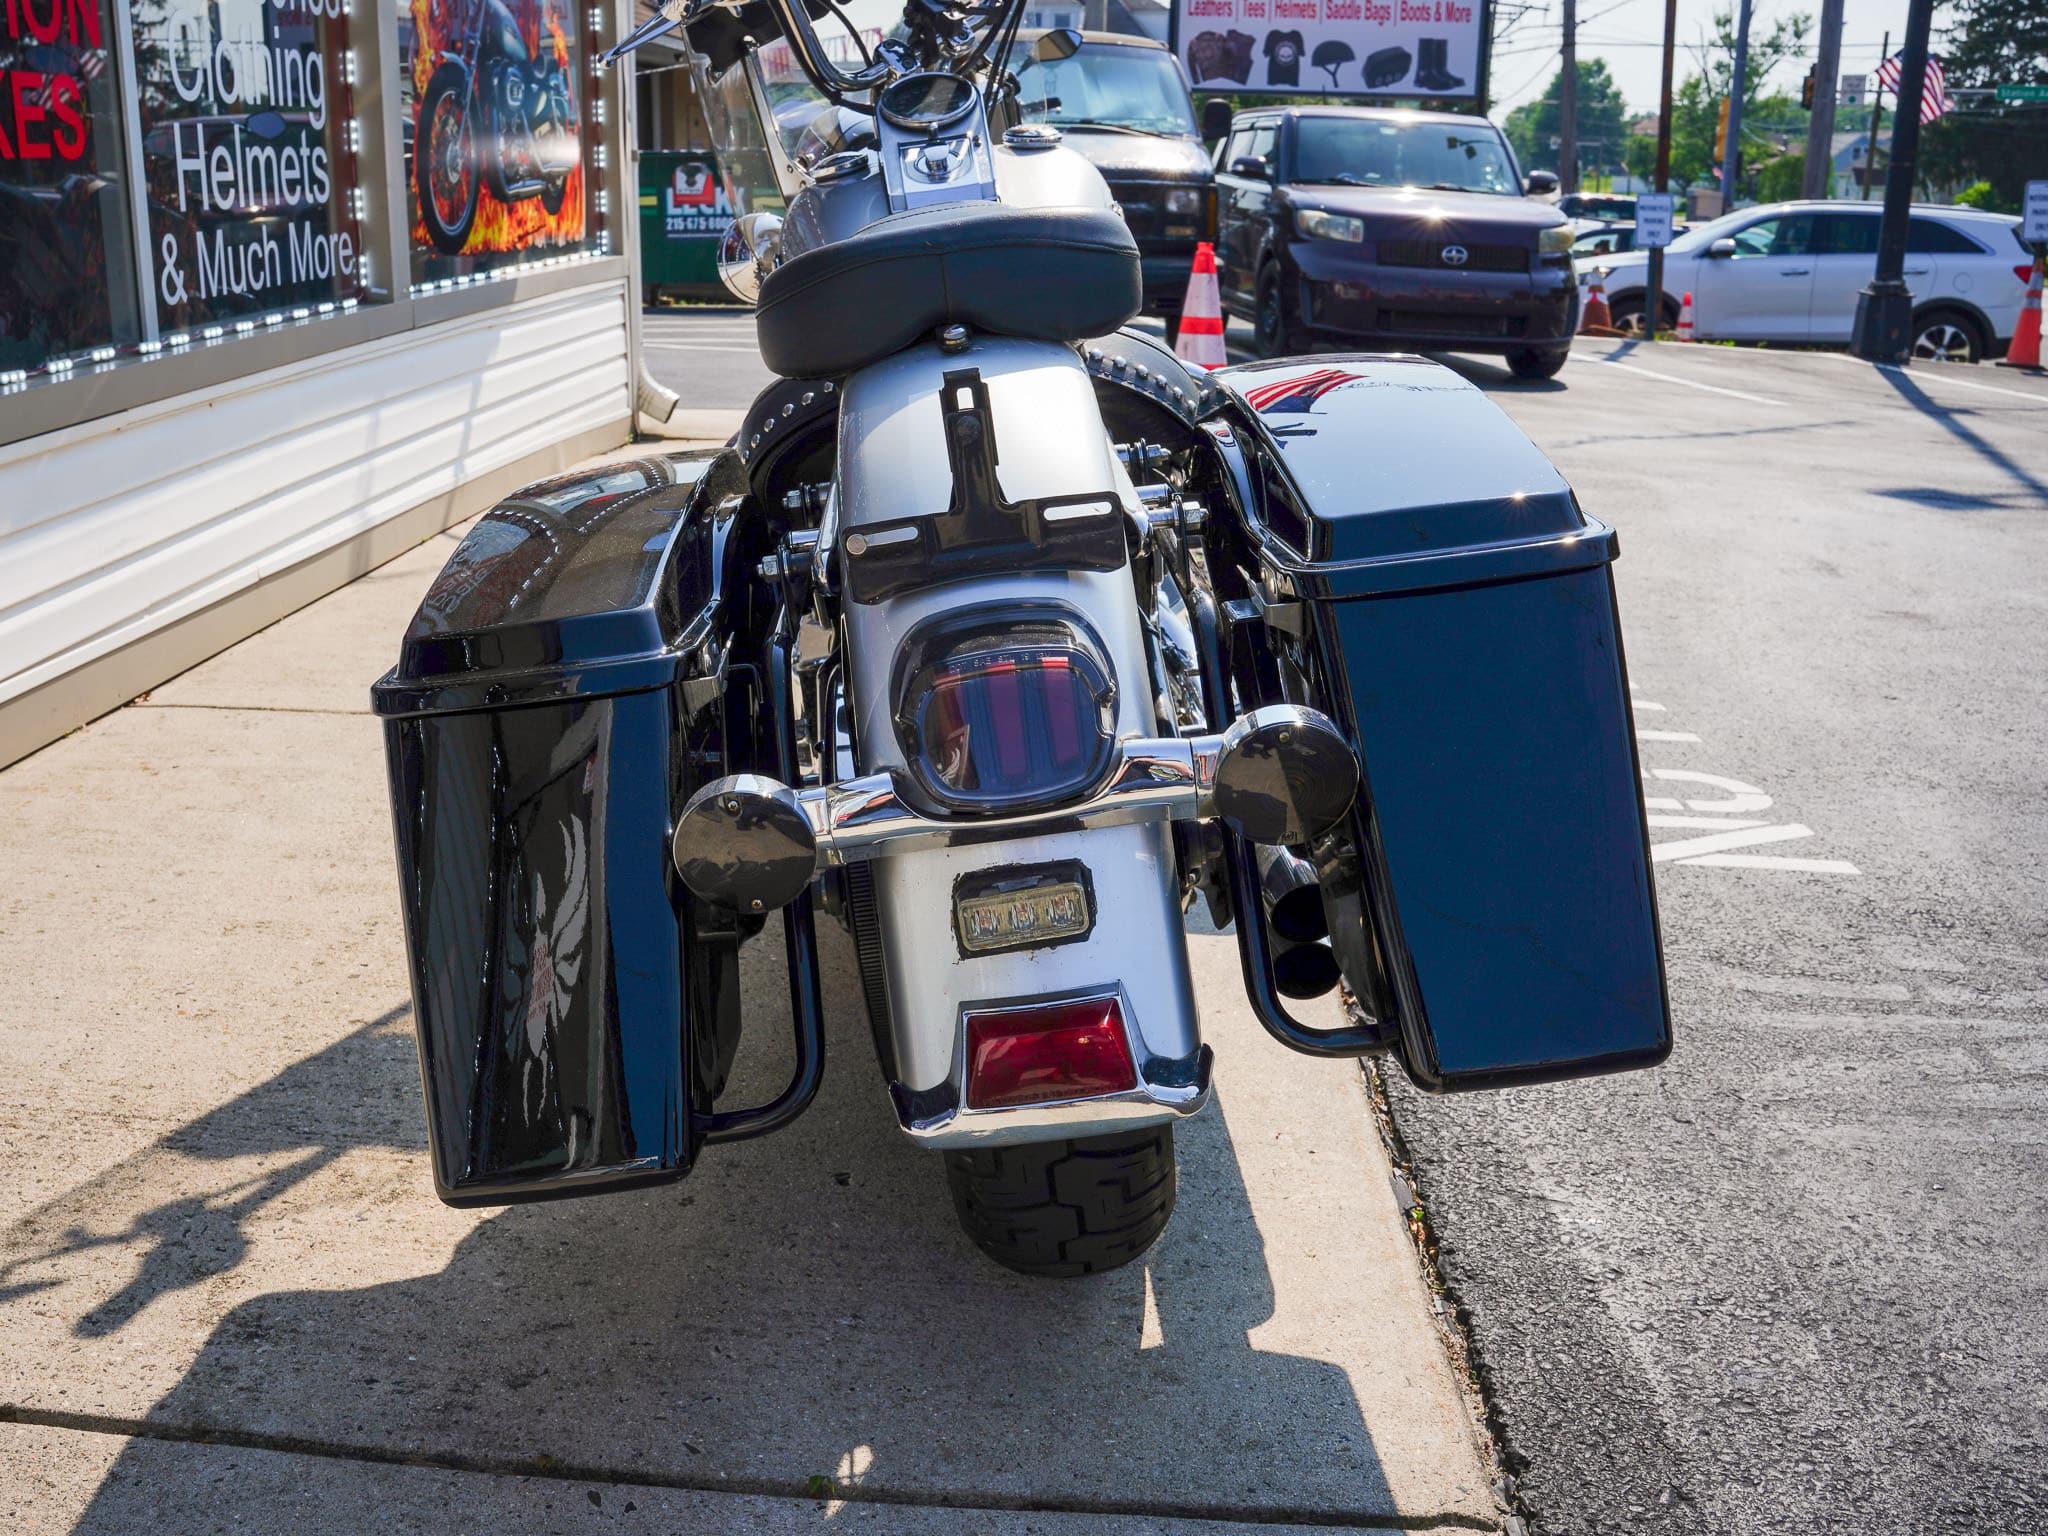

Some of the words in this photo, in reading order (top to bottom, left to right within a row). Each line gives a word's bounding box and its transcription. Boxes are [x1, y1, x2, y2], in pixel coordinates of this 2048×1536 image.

[1187, 0, 1232, 17] Leathers
[1242, 0, 1266, 17] Tees
[1274, 0, 1316, 19] Helmets
[1326, 0, 1361, 20] Saddle
[1364, 0, 1391, 27] Bags
[1400, 0, 1431, 22] Boots
[1434, 1, 1442, 22] &
[1445, 1, 1472, 24] More
[168, 8, 327, 130] Clothing
[0, 70, 86, 160] ES
[173, 122, 331, 212] Helmets
[161, 233, 188, 306] &
[196, 224, 282, 300] Much
[289, 221, 355, 284] More
